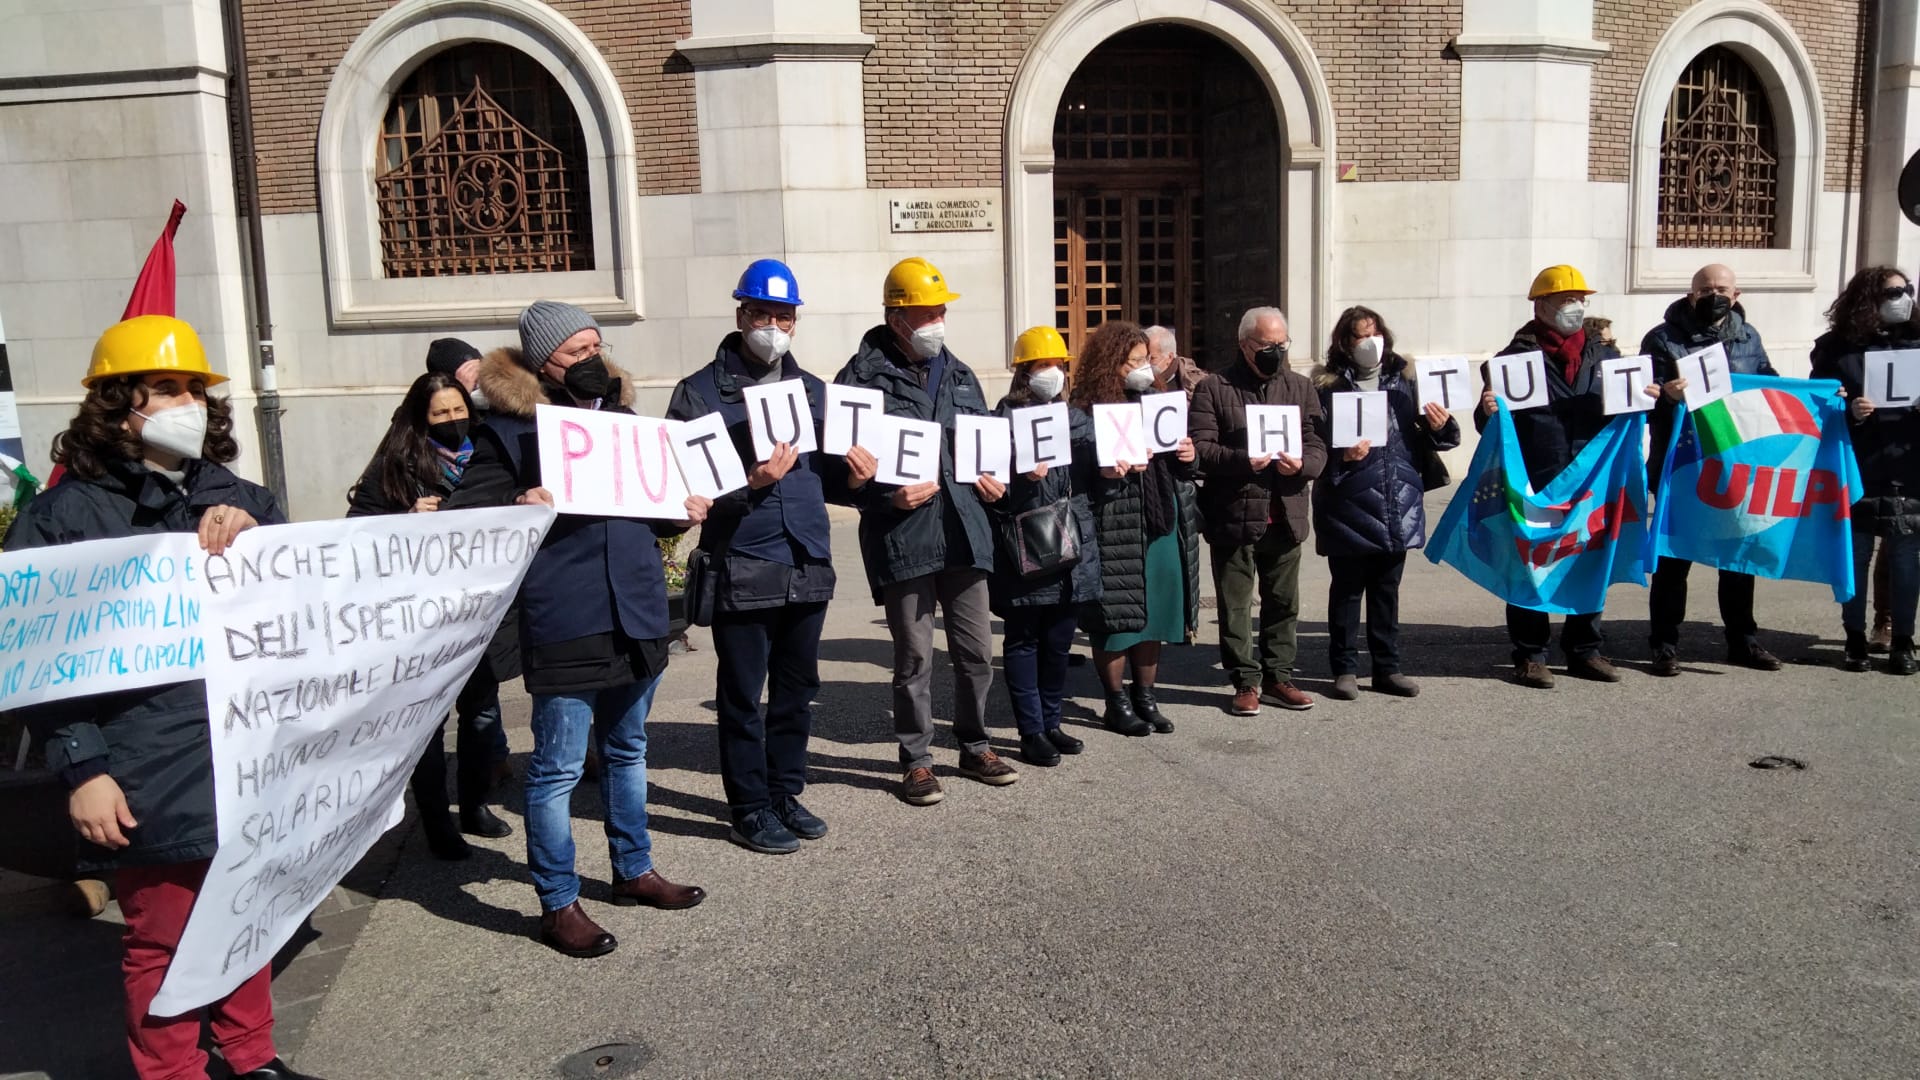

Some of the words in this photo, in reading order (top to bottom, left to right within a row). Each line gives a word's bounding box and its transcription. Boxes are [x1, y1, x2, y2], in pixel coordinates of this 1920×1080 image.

[900, 211, 935, 219] INDUSTRIA
[939, 210, 986, 219] ARTIGIANATO
[906, 201, 933, 210] CAMERA
[936, 200, 980, 209] COMMERCIO
[914, 221, 919, 229] E
[926, 220, 974, 229] AGRICOLTURA
[1428, 369, 1458, 409] T
[1501, 360, 1535, 402] U
[1614, 367, 1641, 408] T
[1886, 362, 1910, 401] L
[760, 393, 801, 447] U
[840, 401, 871, 447] T
[1031, 416, 1056, 463] E
[1107, 411, 1138, 457] X
[1153, 406, 1178, 448] C
[1259, 414, 1289, 453] H
[560, 419, 667, 505] PIU
[686, 433, 717, 490] T
[896, 429, 924, 479] E
[976, 429, 996, 476] L
[47, 566, 77, 604] SUL
[88, 553, 175, 592] LAVORO
[185, 556, 196, 581] E
[204, 543, 340, 594] ANCHE
[372, 526, 541, 577] LAVORATOR
[109, 647, 128, 675] AL
[224, 663, 384, 738] NAZIONALE
[392, 653, 425, 685] DEL
[236, 729, 339, 798] HANNO
[226, 769, 362, 873] SALARIO
